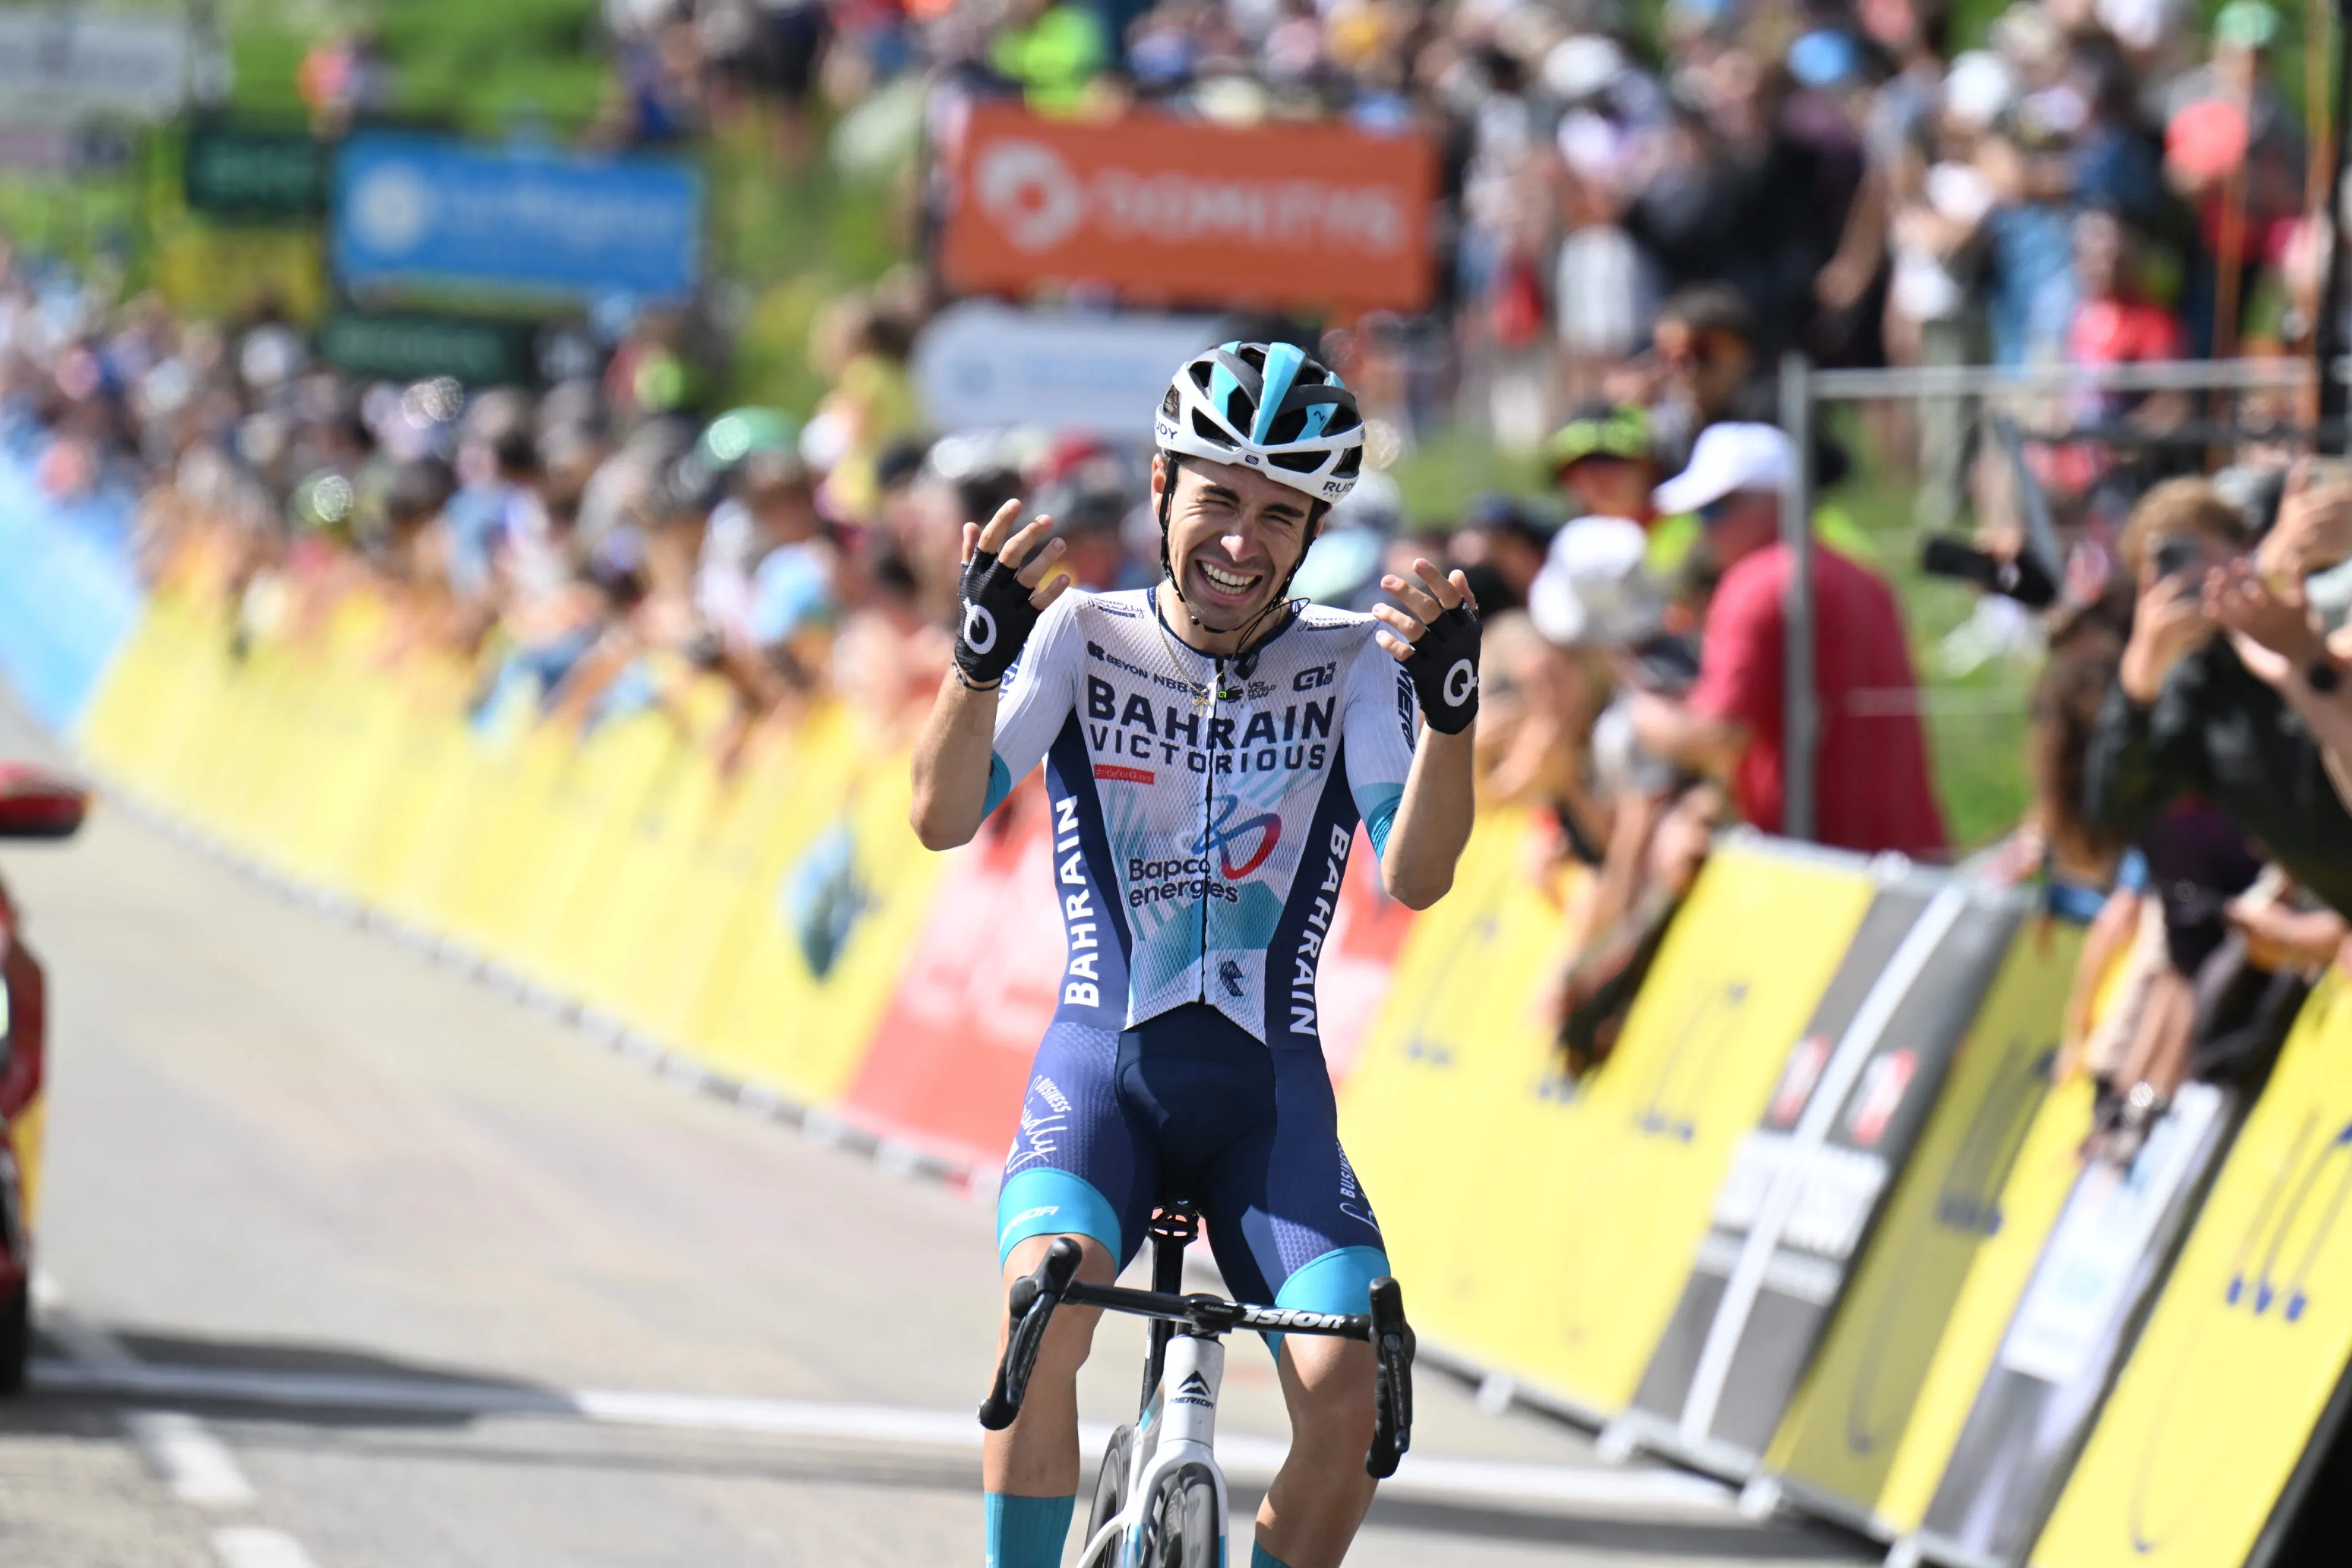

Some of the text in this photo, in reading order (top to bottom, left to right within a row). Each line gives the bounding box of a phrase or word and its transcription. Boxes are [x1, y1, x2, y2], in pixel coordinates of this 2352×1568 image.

[1156, 421, 1177, 439] UDY
[1323, 481, 1355, 493] RUD
[1107, 654, 1148, 679] BEYON
[1248, 684, 1276, 693] WORLD
[1088, 674, 1336, 750] BAHRAIN
[1090, 723, 1325, 774] VICTORIOUS
[1129, 859, 1210, 881] Bapco
[1056, 795, 1099, 1007] BAHRAIN
[1129, 876, 1238, 907] energies
[1290, 824, 1350, 1036] BAHRAIN
[1035, 1078, 1071, 1112] BUSINESS
[1205, 1305, 1232, 1314] GARMIN
[1224, 1302, 1346, 1329] ision
[1169, 1397, 1214, 1409] MERIDA
